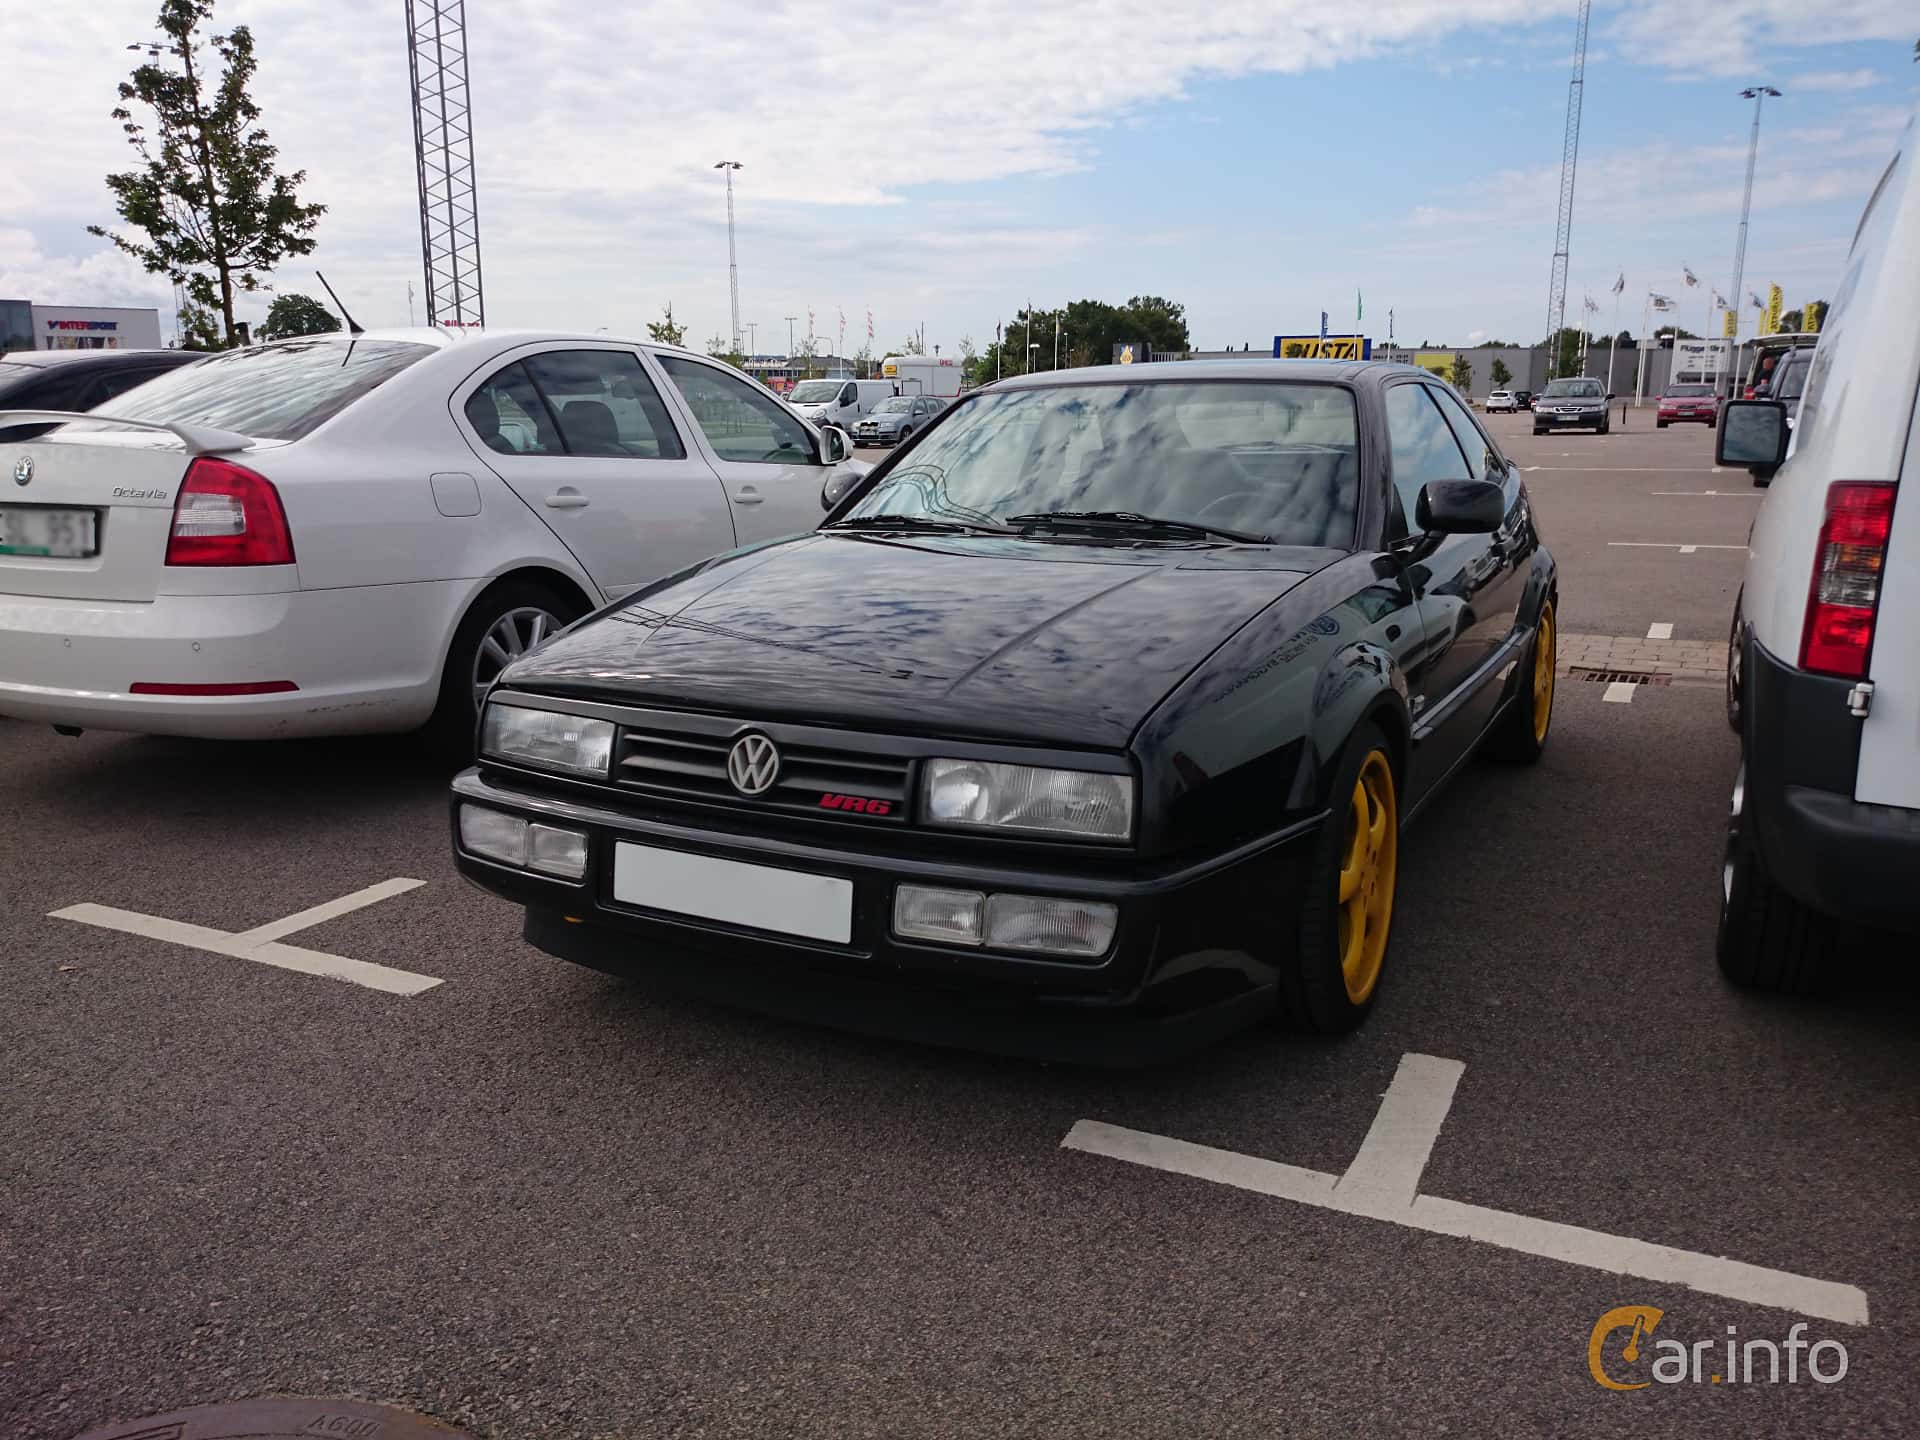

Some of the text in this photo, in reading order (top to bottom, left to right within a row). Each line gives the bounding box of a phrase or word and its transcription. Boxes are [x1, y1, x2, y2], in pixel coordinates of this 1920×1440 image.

[113, 487, 168, 499] Octavia
[728, 735, 779, 793] VW
[820, 793, 891, 814] VR6
